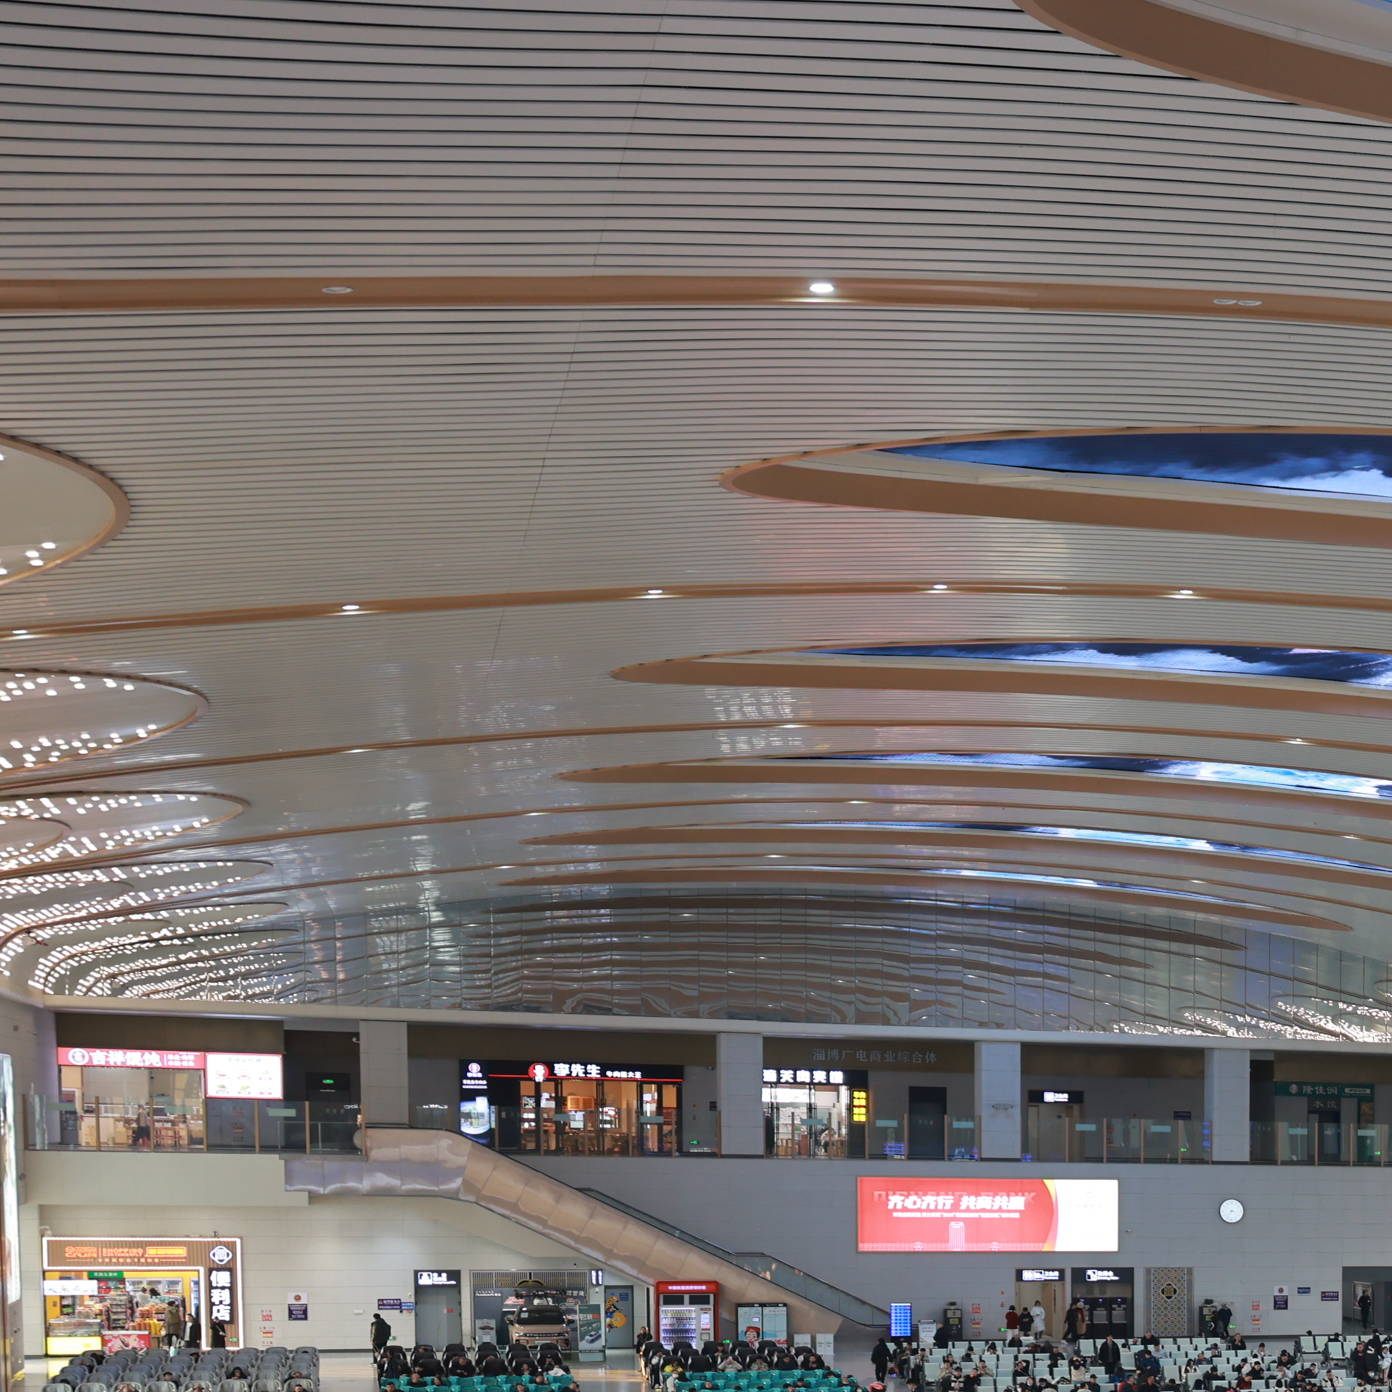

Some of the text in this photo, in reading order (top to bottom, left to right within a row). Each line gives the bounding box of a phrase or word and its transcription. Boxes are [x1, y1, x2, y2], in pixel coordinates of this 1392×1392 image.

[90, 1050, 161, 1066] 吉祥馄饨
[813, 1049, 937, 1064] 淄博广电商业综合体
[554, 1063, 600, 1078] 李先生
[210, 1270, 231, 1322] 便利店
